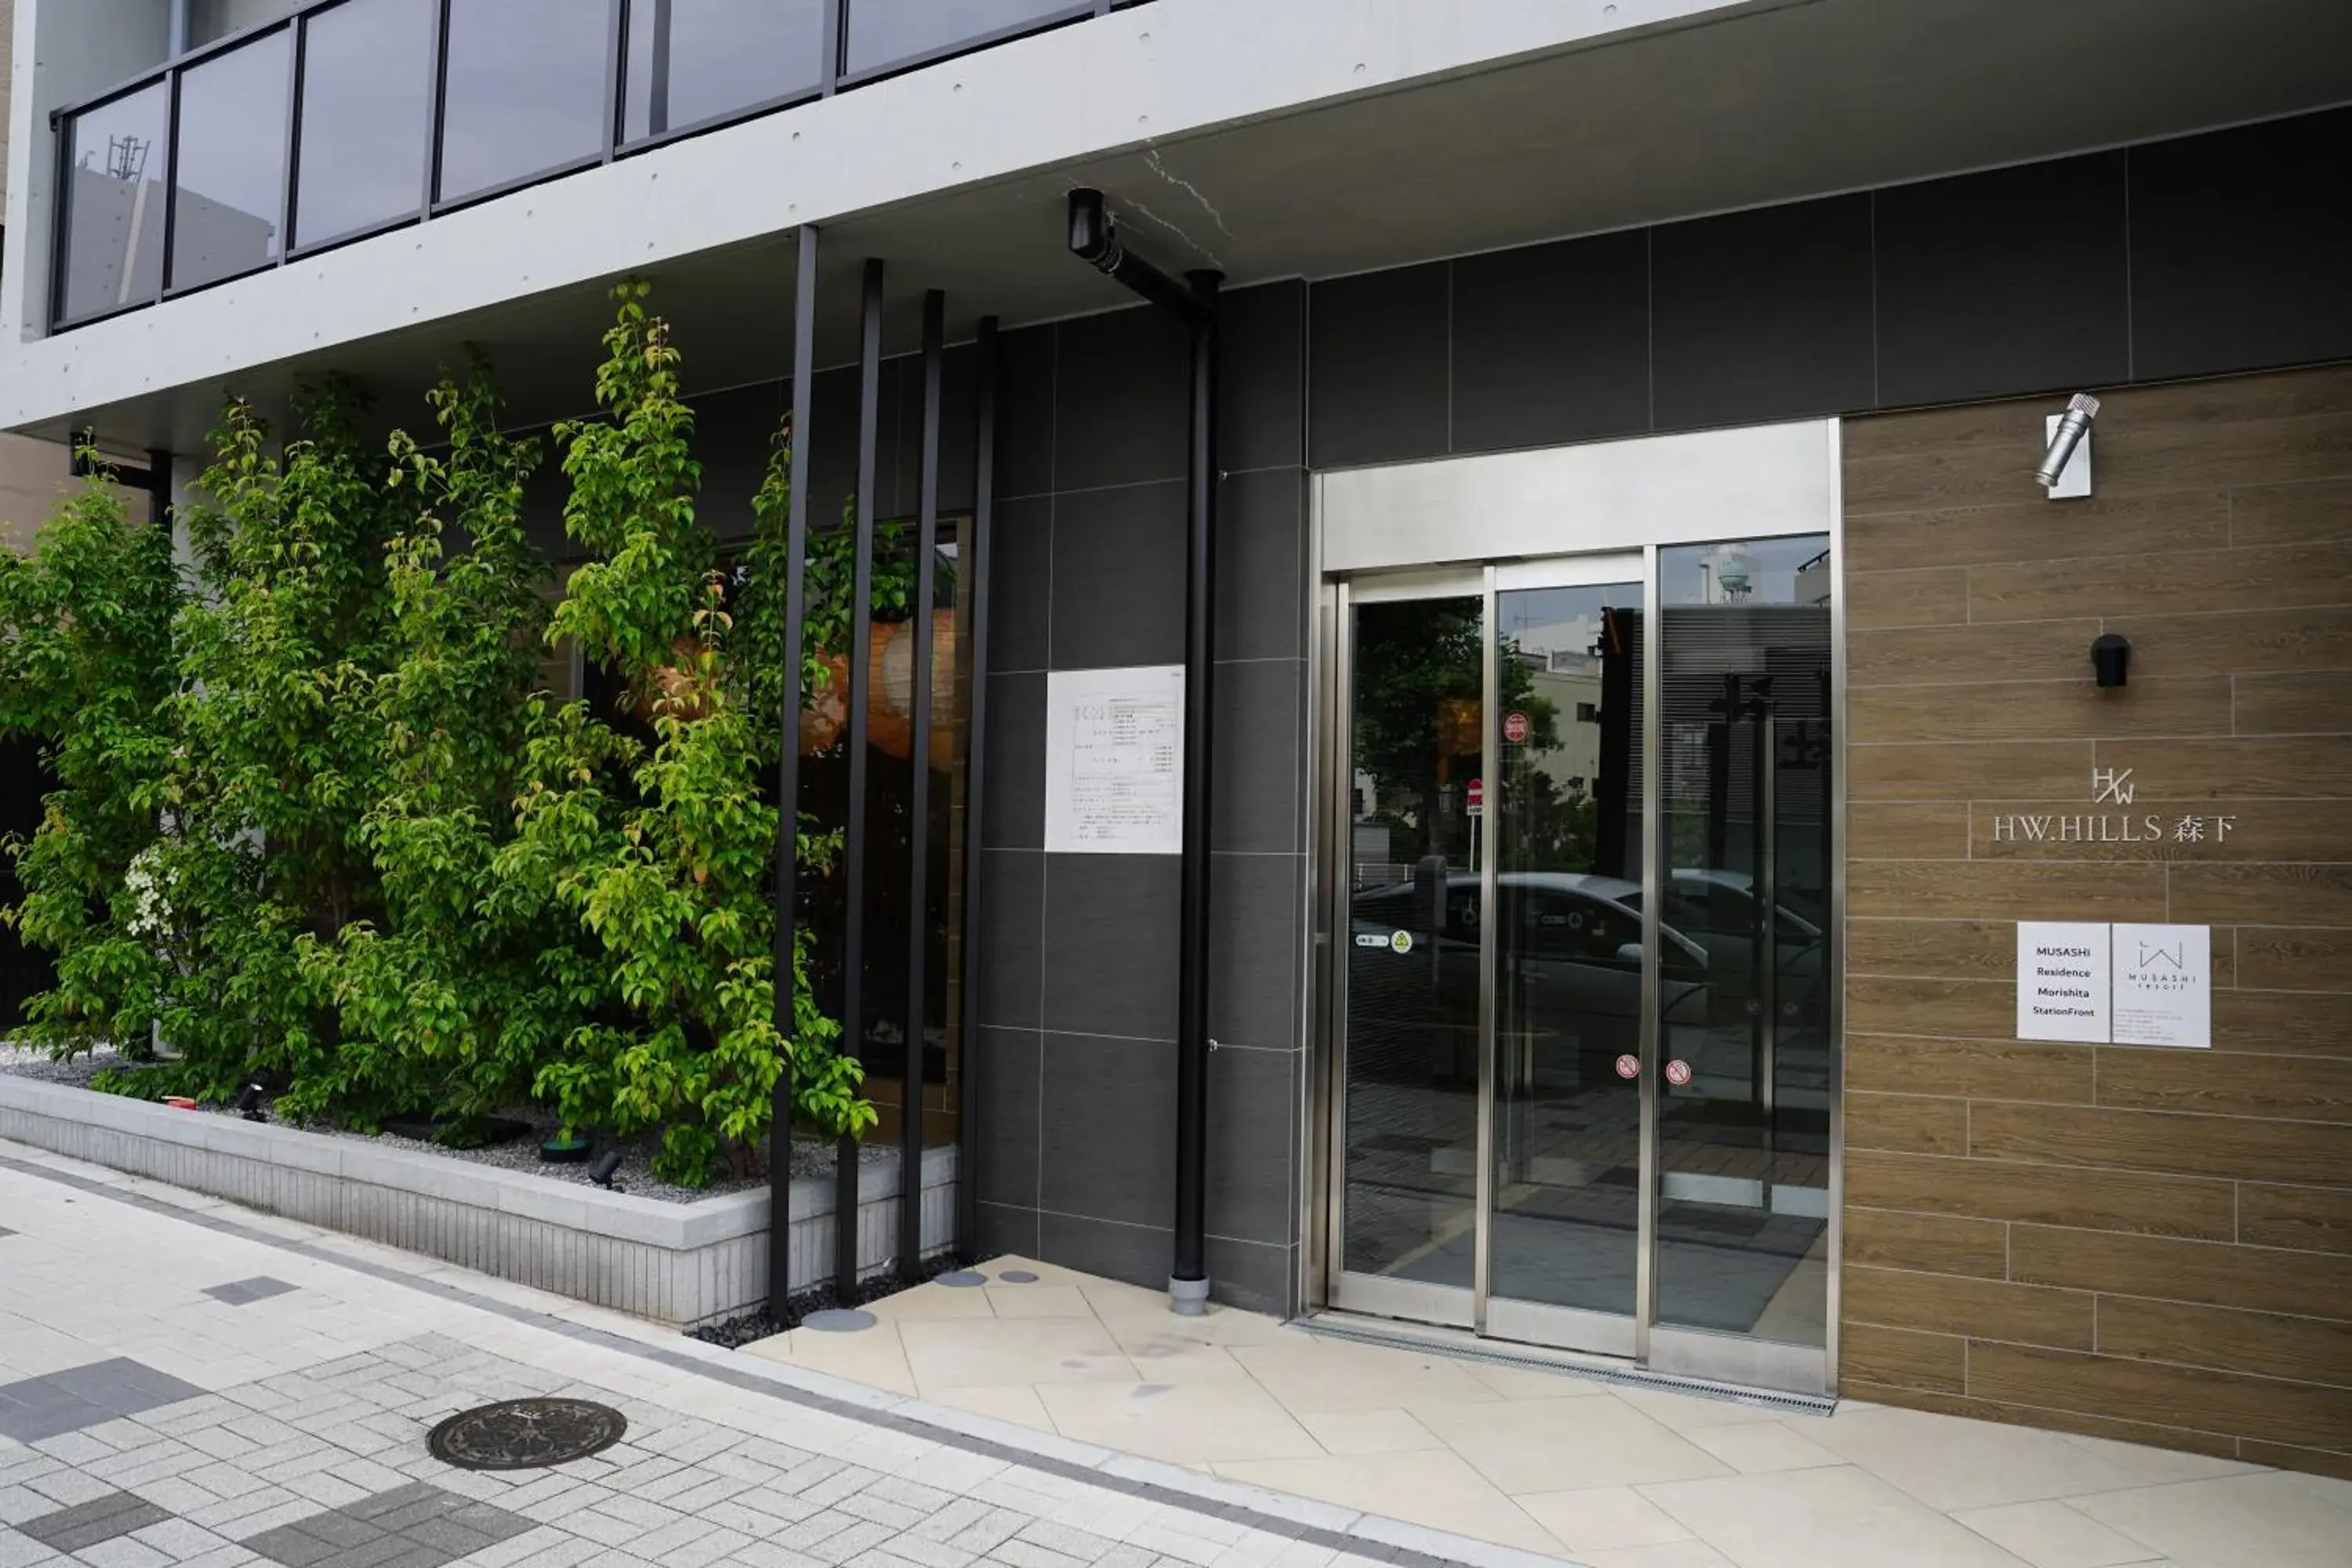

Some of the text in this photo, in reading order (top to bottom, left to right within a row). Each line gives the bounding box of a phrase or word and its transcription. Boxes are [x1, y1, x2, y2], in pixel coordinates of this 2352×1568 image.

[1994, 815, 2237, 843] HW.HILLS 森下
[2036, 947, 2091, 956] MUSASHI
[2036, 967, 2091, 978] Residence
[2128, 973, 2196, 983] MUSASHI
[2038, 988, 2089, 998] Morishita
[2033, 1006, 2095, 1017] StationFront
